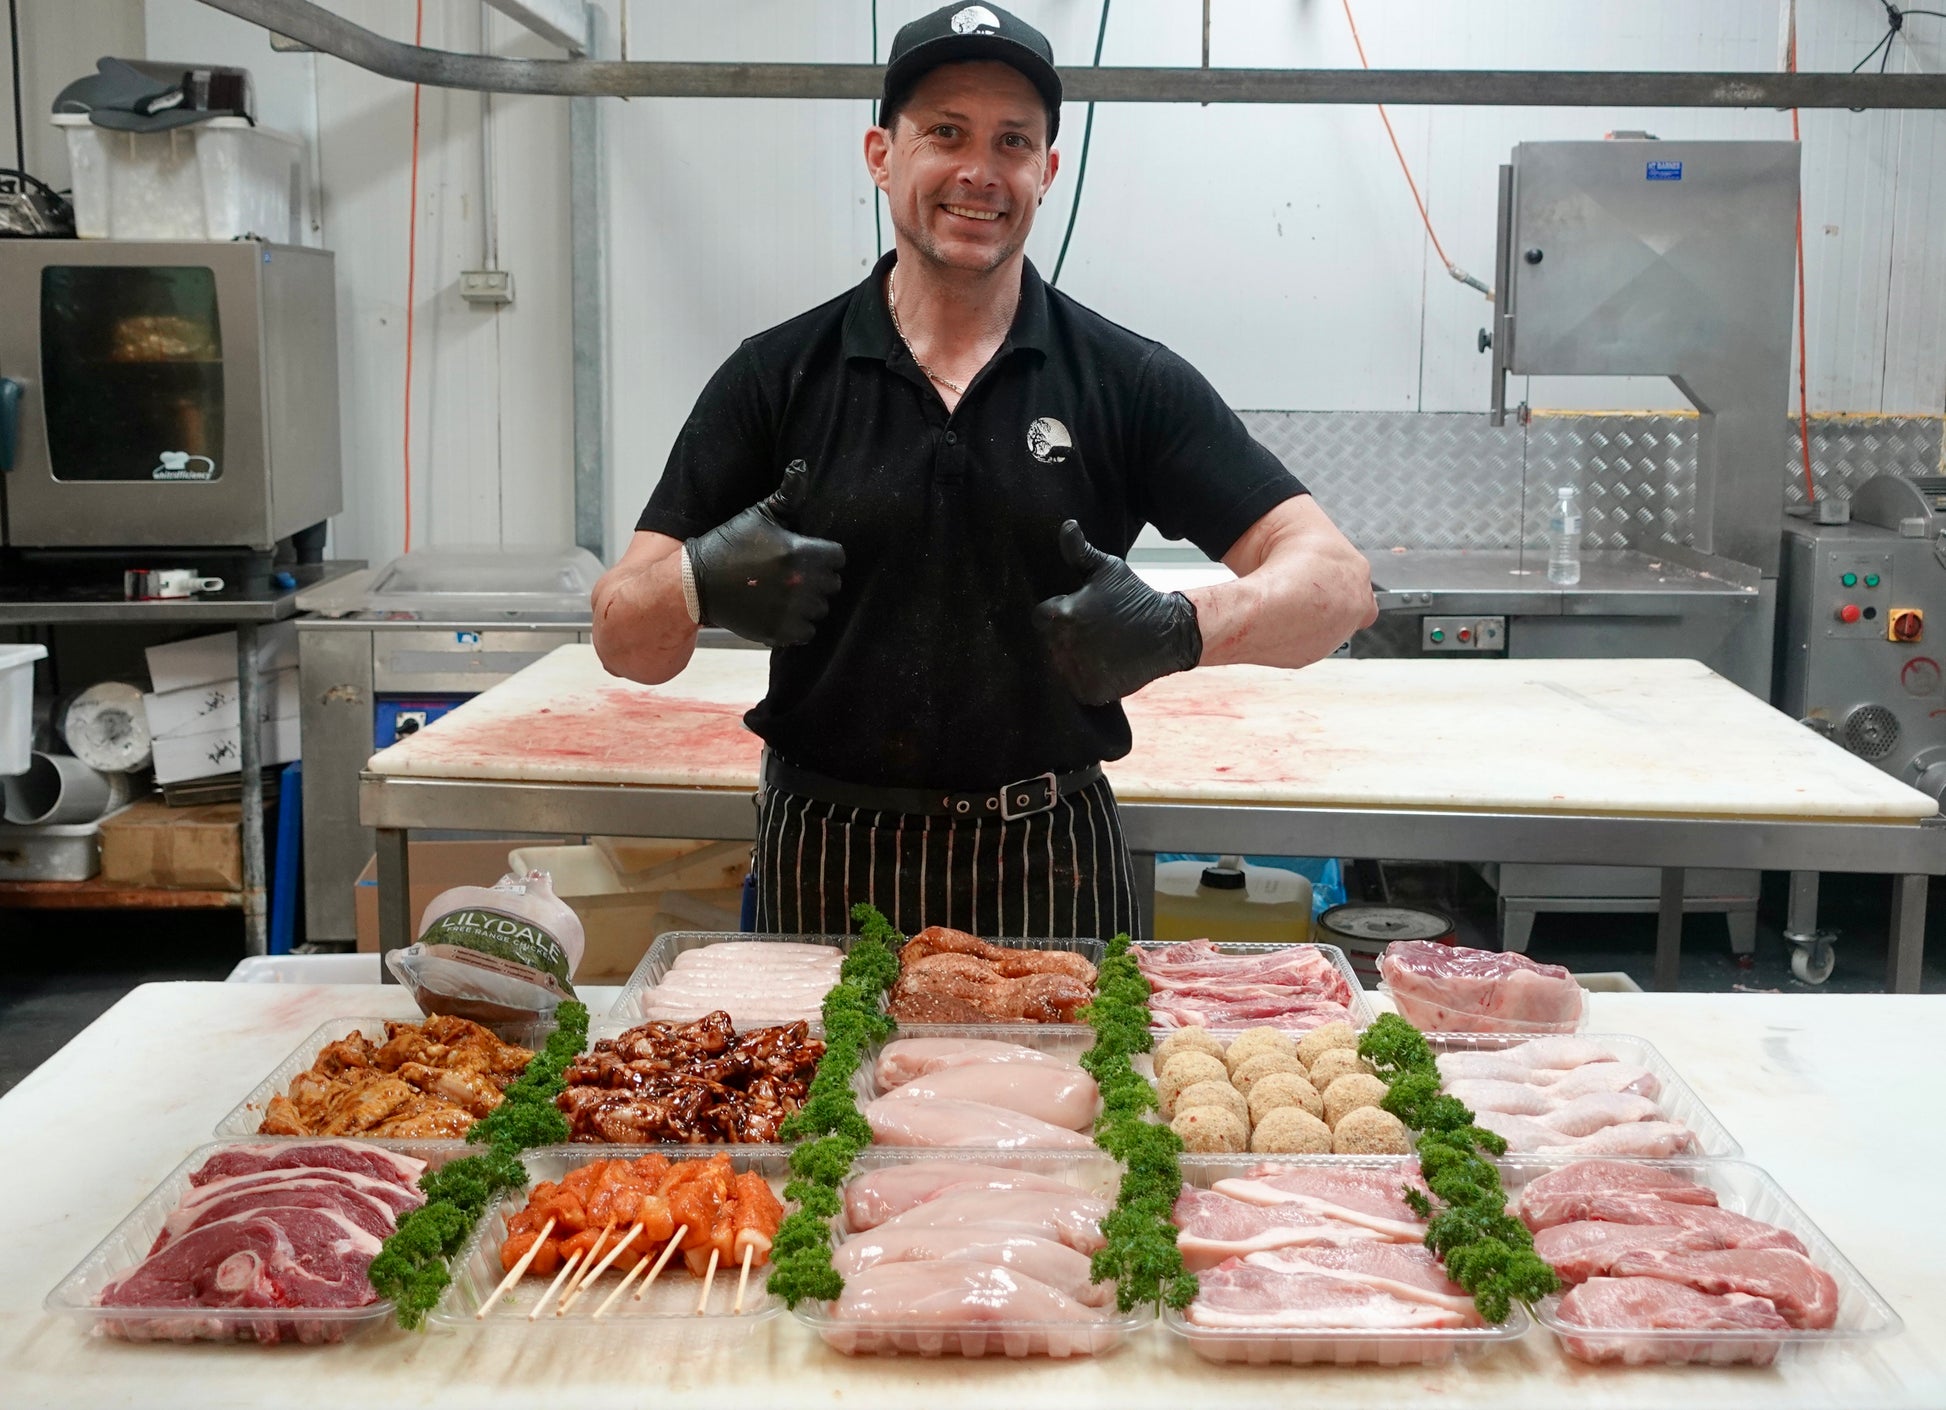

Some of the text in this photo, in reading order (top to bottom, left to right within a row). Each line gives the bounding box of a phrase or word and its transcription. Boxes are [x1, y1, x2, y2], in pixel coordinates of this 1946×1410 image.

[441, 912, 561, 964] LILYDALE
[446, 925, 472, 934] FREE
[475, 928, 511, 943] RANGE
